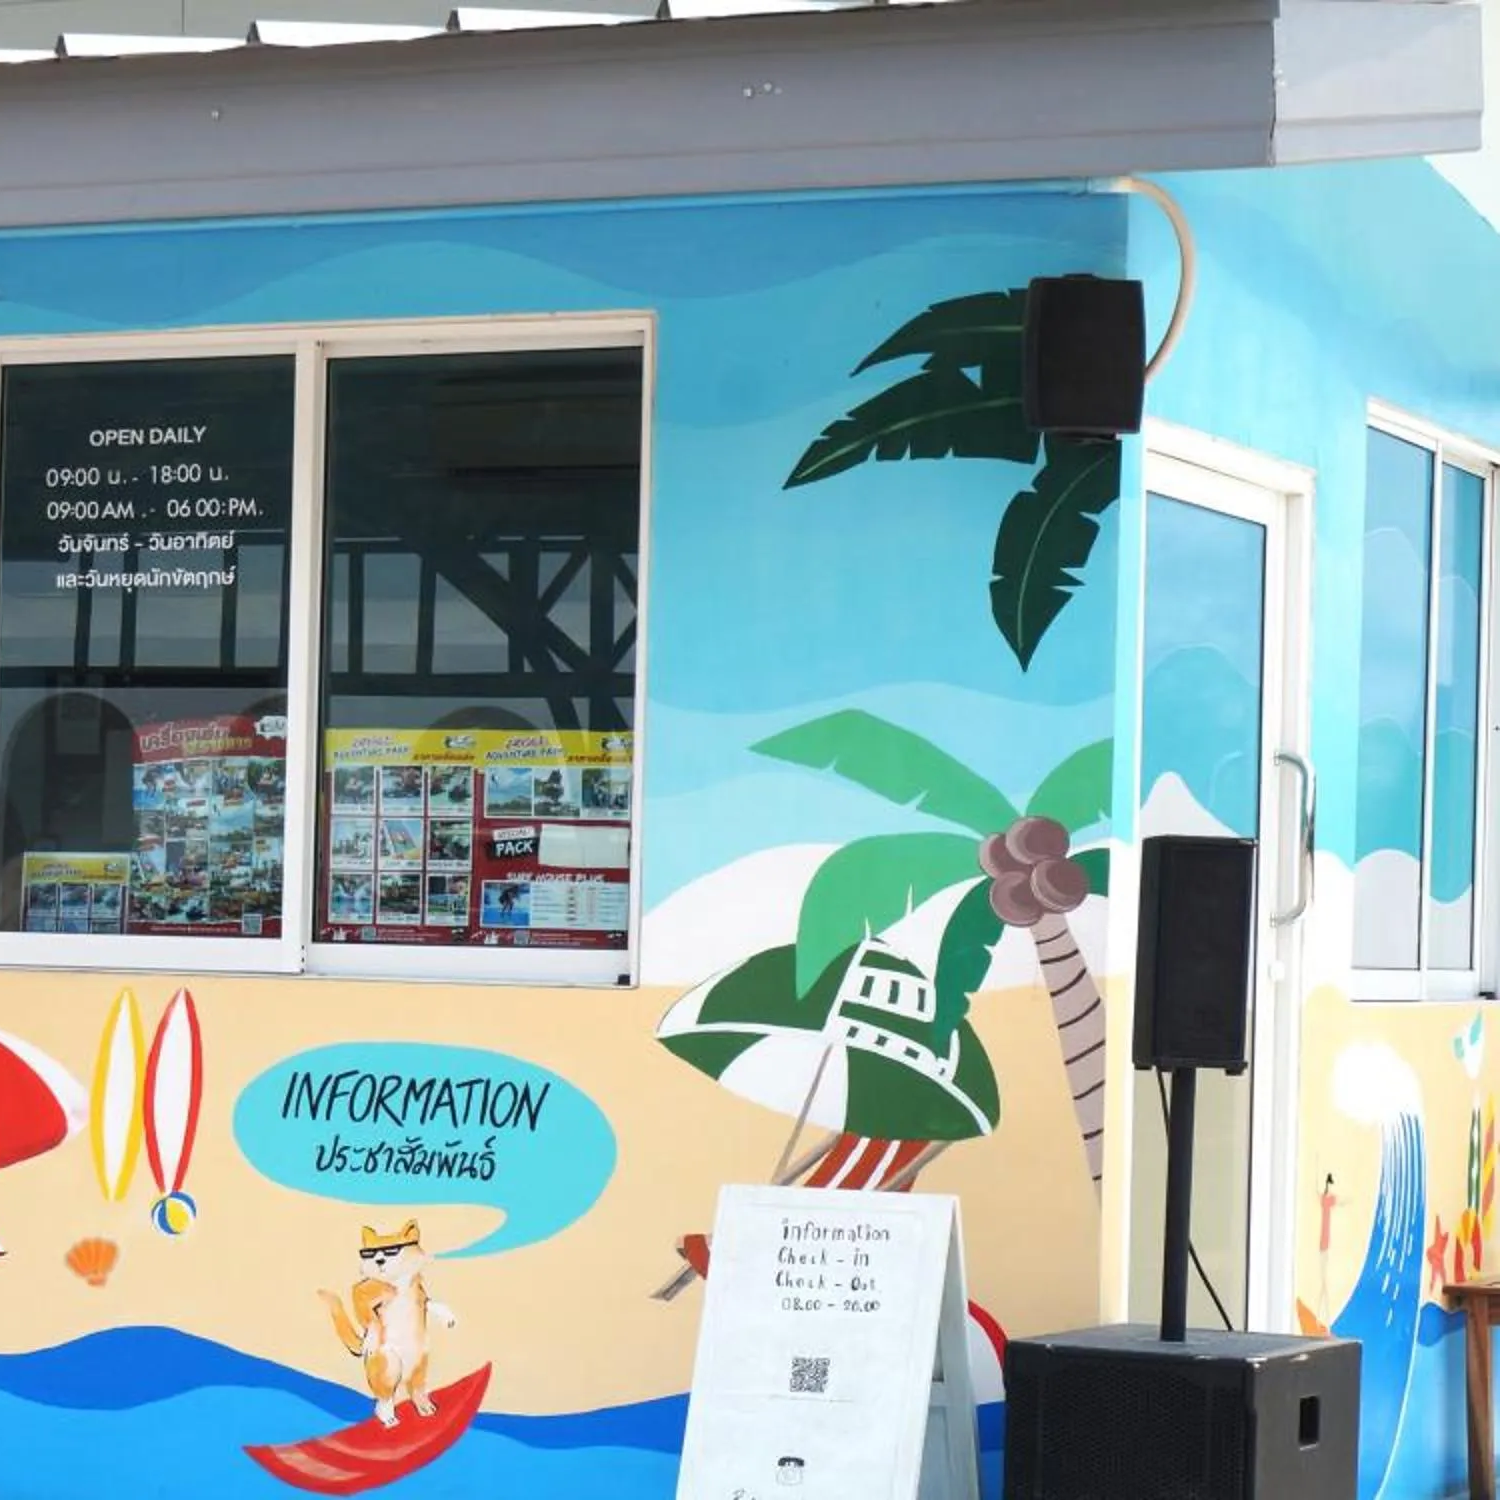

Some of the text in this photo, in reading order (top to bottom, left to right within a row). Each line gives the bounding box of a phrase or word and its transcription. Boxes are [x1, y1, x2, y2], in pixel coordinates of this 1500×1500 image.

[89, 426, 207, 447] OPEN DAILY
[45, 467, 100, 487] 09:00
[149, 464, 201, 484] 18:00
[46, 501, 99, 520] 09:00
[58, 532, 129, 553] วันจันทร์
[148, 529, 235, 550] วันอาทิตย์
[56, 565, 236, 593] และวันหยุดนักขัตฤกษ์
[495, 840, 534, 857] PACK
[281, 1069, 550, 1132] INFORMATION
[314, 1134, 498, 1182] ประชาสัมพันธ์
[781, 1218, 891, 1242] information
[777, 1246, 827, 1266] Check
[775, 1270, 826, 1290] Check
